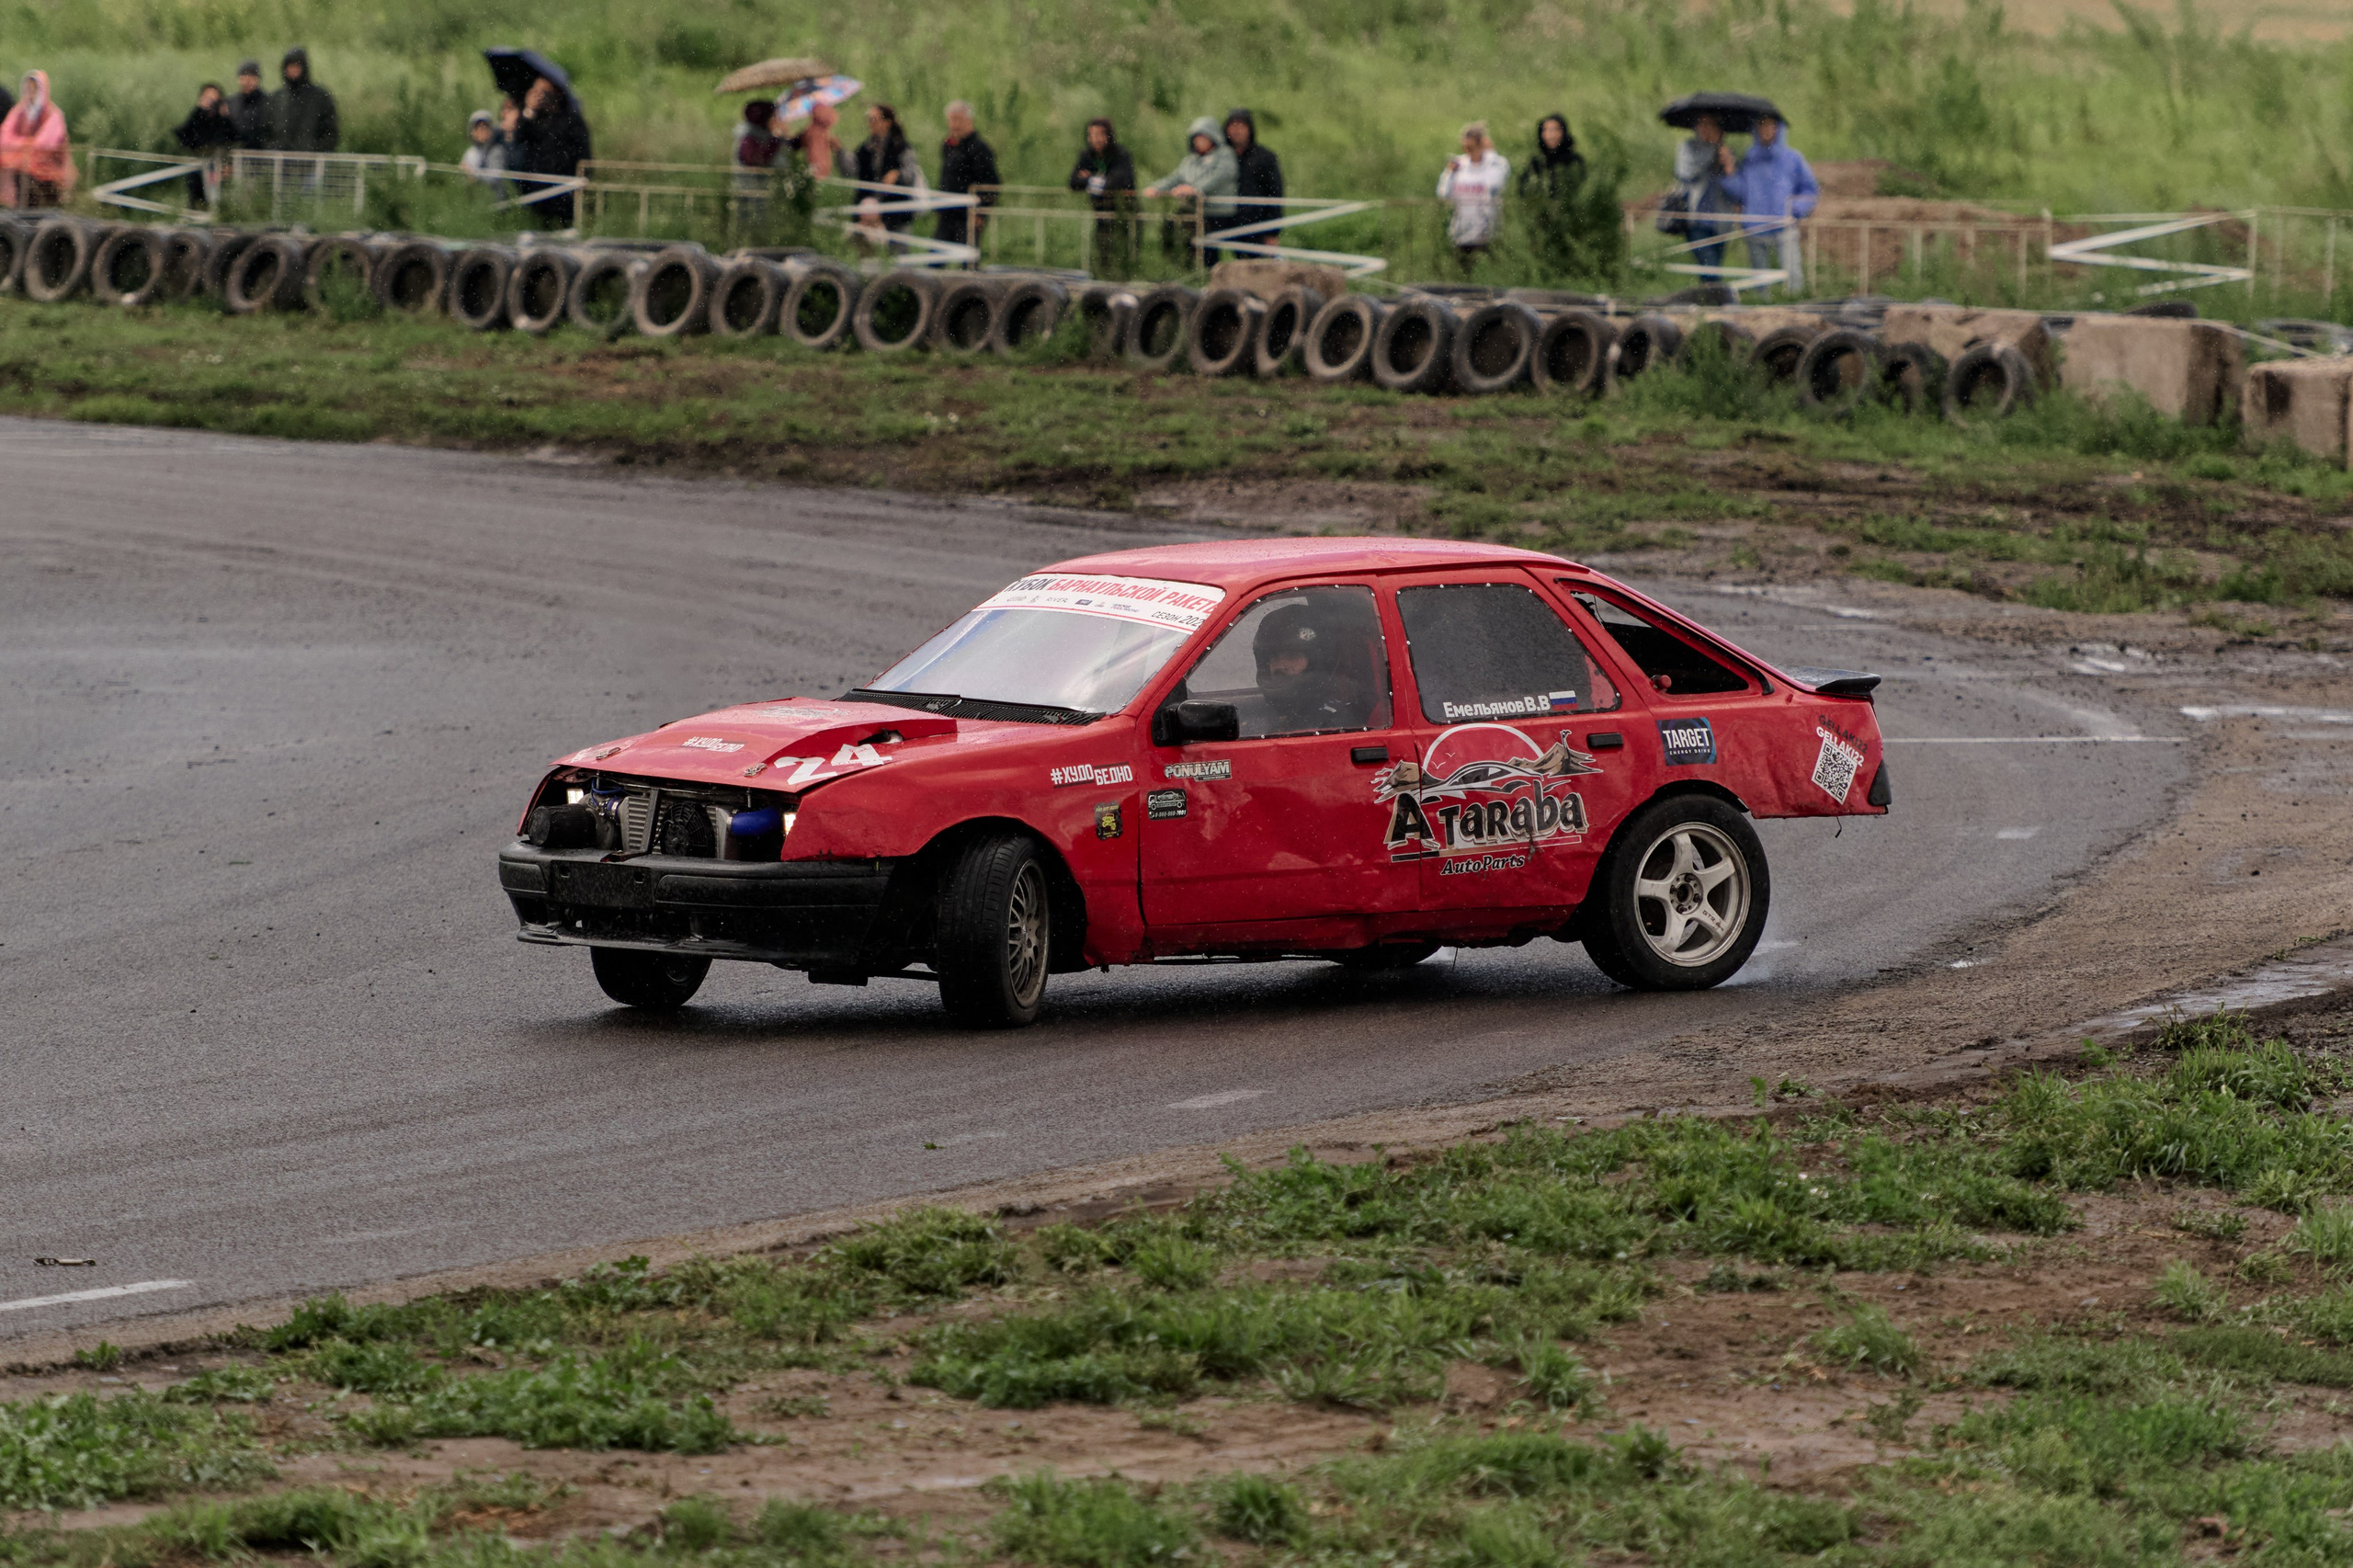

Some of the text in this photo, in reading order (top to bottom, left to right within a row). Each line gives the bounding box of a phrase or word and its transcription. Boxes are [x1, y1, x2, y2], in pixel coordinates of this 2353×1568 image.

[1046, 578, 1170, 602] БАРНАУЛЬСКОЙ
[1151, 610, 1181, 622] СЕЗОН
[1443, 701, 1526, 718] Емельянов
[1662, 727, 1710, 749] TARGET
[1818, 714, 1869, 754] GELLAKI22
[1815, 726, 1865, 767] GELLAKI22
[773, 743, 892, 786] 24
[1165, 760, 1230, 779] PONULYAM
[1440, 854, 1526, 875] AutoParts
